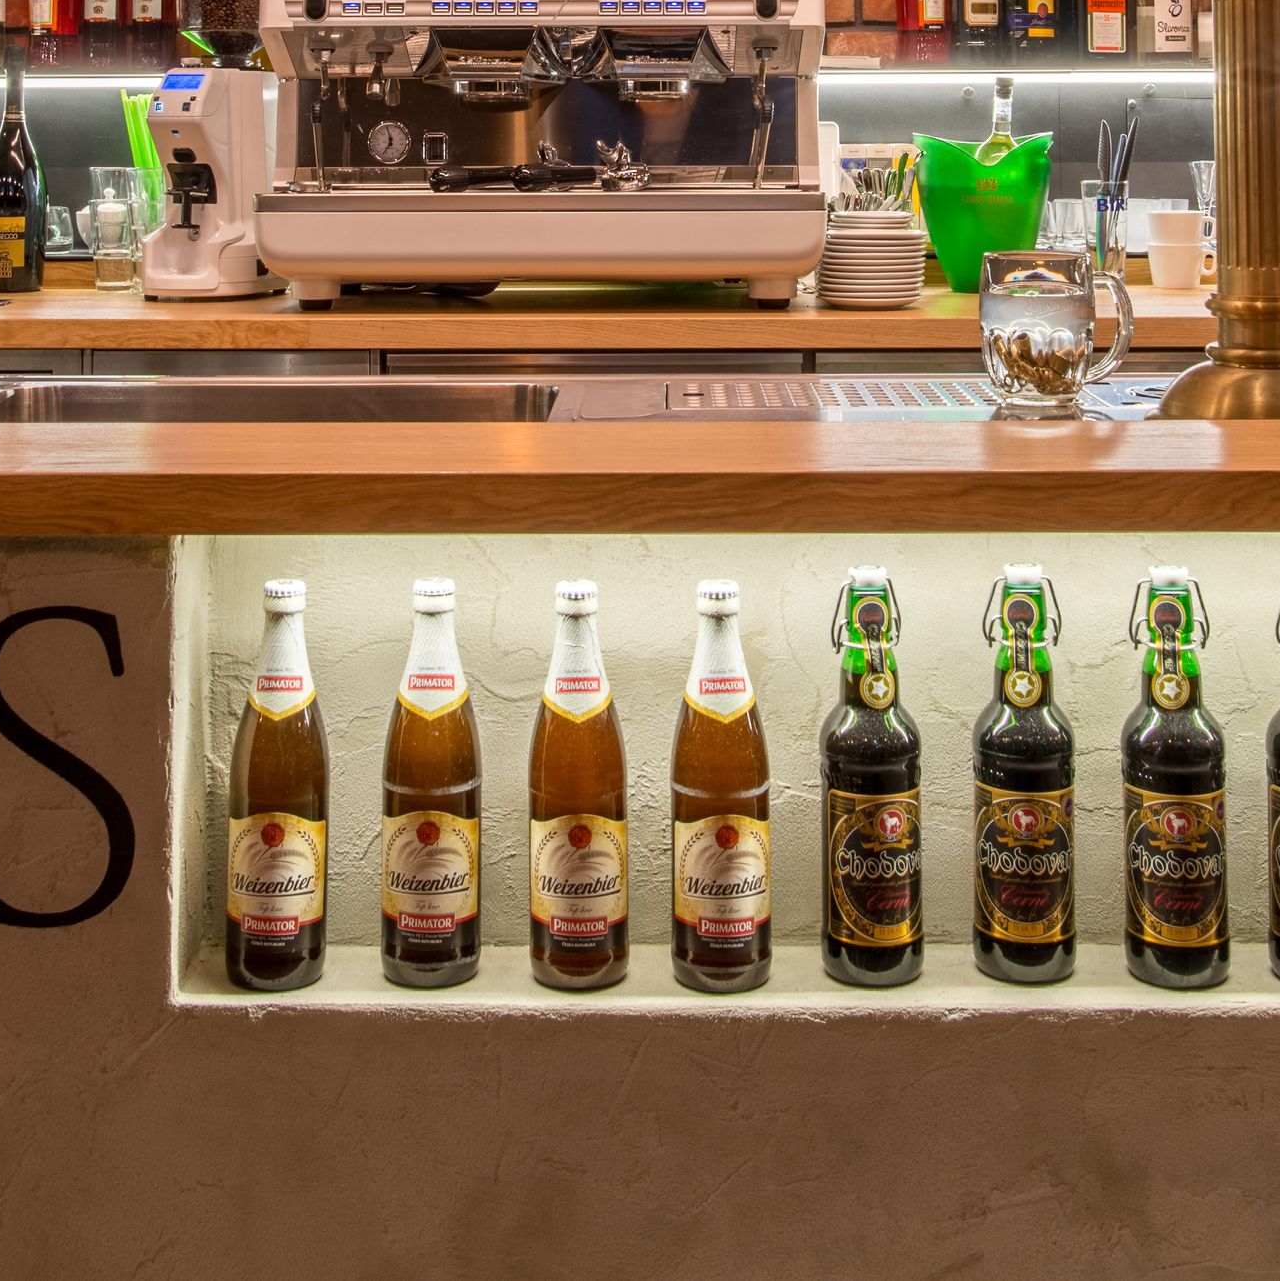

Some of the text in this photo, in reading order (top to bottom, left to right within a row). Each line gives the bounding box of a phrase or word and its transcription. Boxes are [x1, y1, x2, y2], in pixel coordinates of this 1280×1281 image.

[259, 677, 302, 689] PRIMATOR
[410, 676, 454, 688] PRIMATOR
[556, 678, 599, 691] PRIMATOR
[702, 680, 745, 692] PRIMATOR
[233, 872, 315, 894] Weizenbier
[388, 871, 469, 893] Weizenbier
[539, 874, 620, 896] Weizenbier
[685, 874, 766, 896] Weizenbier
[244, 918, 296, 931] PRIMATOR
[401, 917, 452, 929] PRIMATOR
[553, 920, 605, 932] PRIMATOR
[701, 920, 752, 932] PRIMATOR
